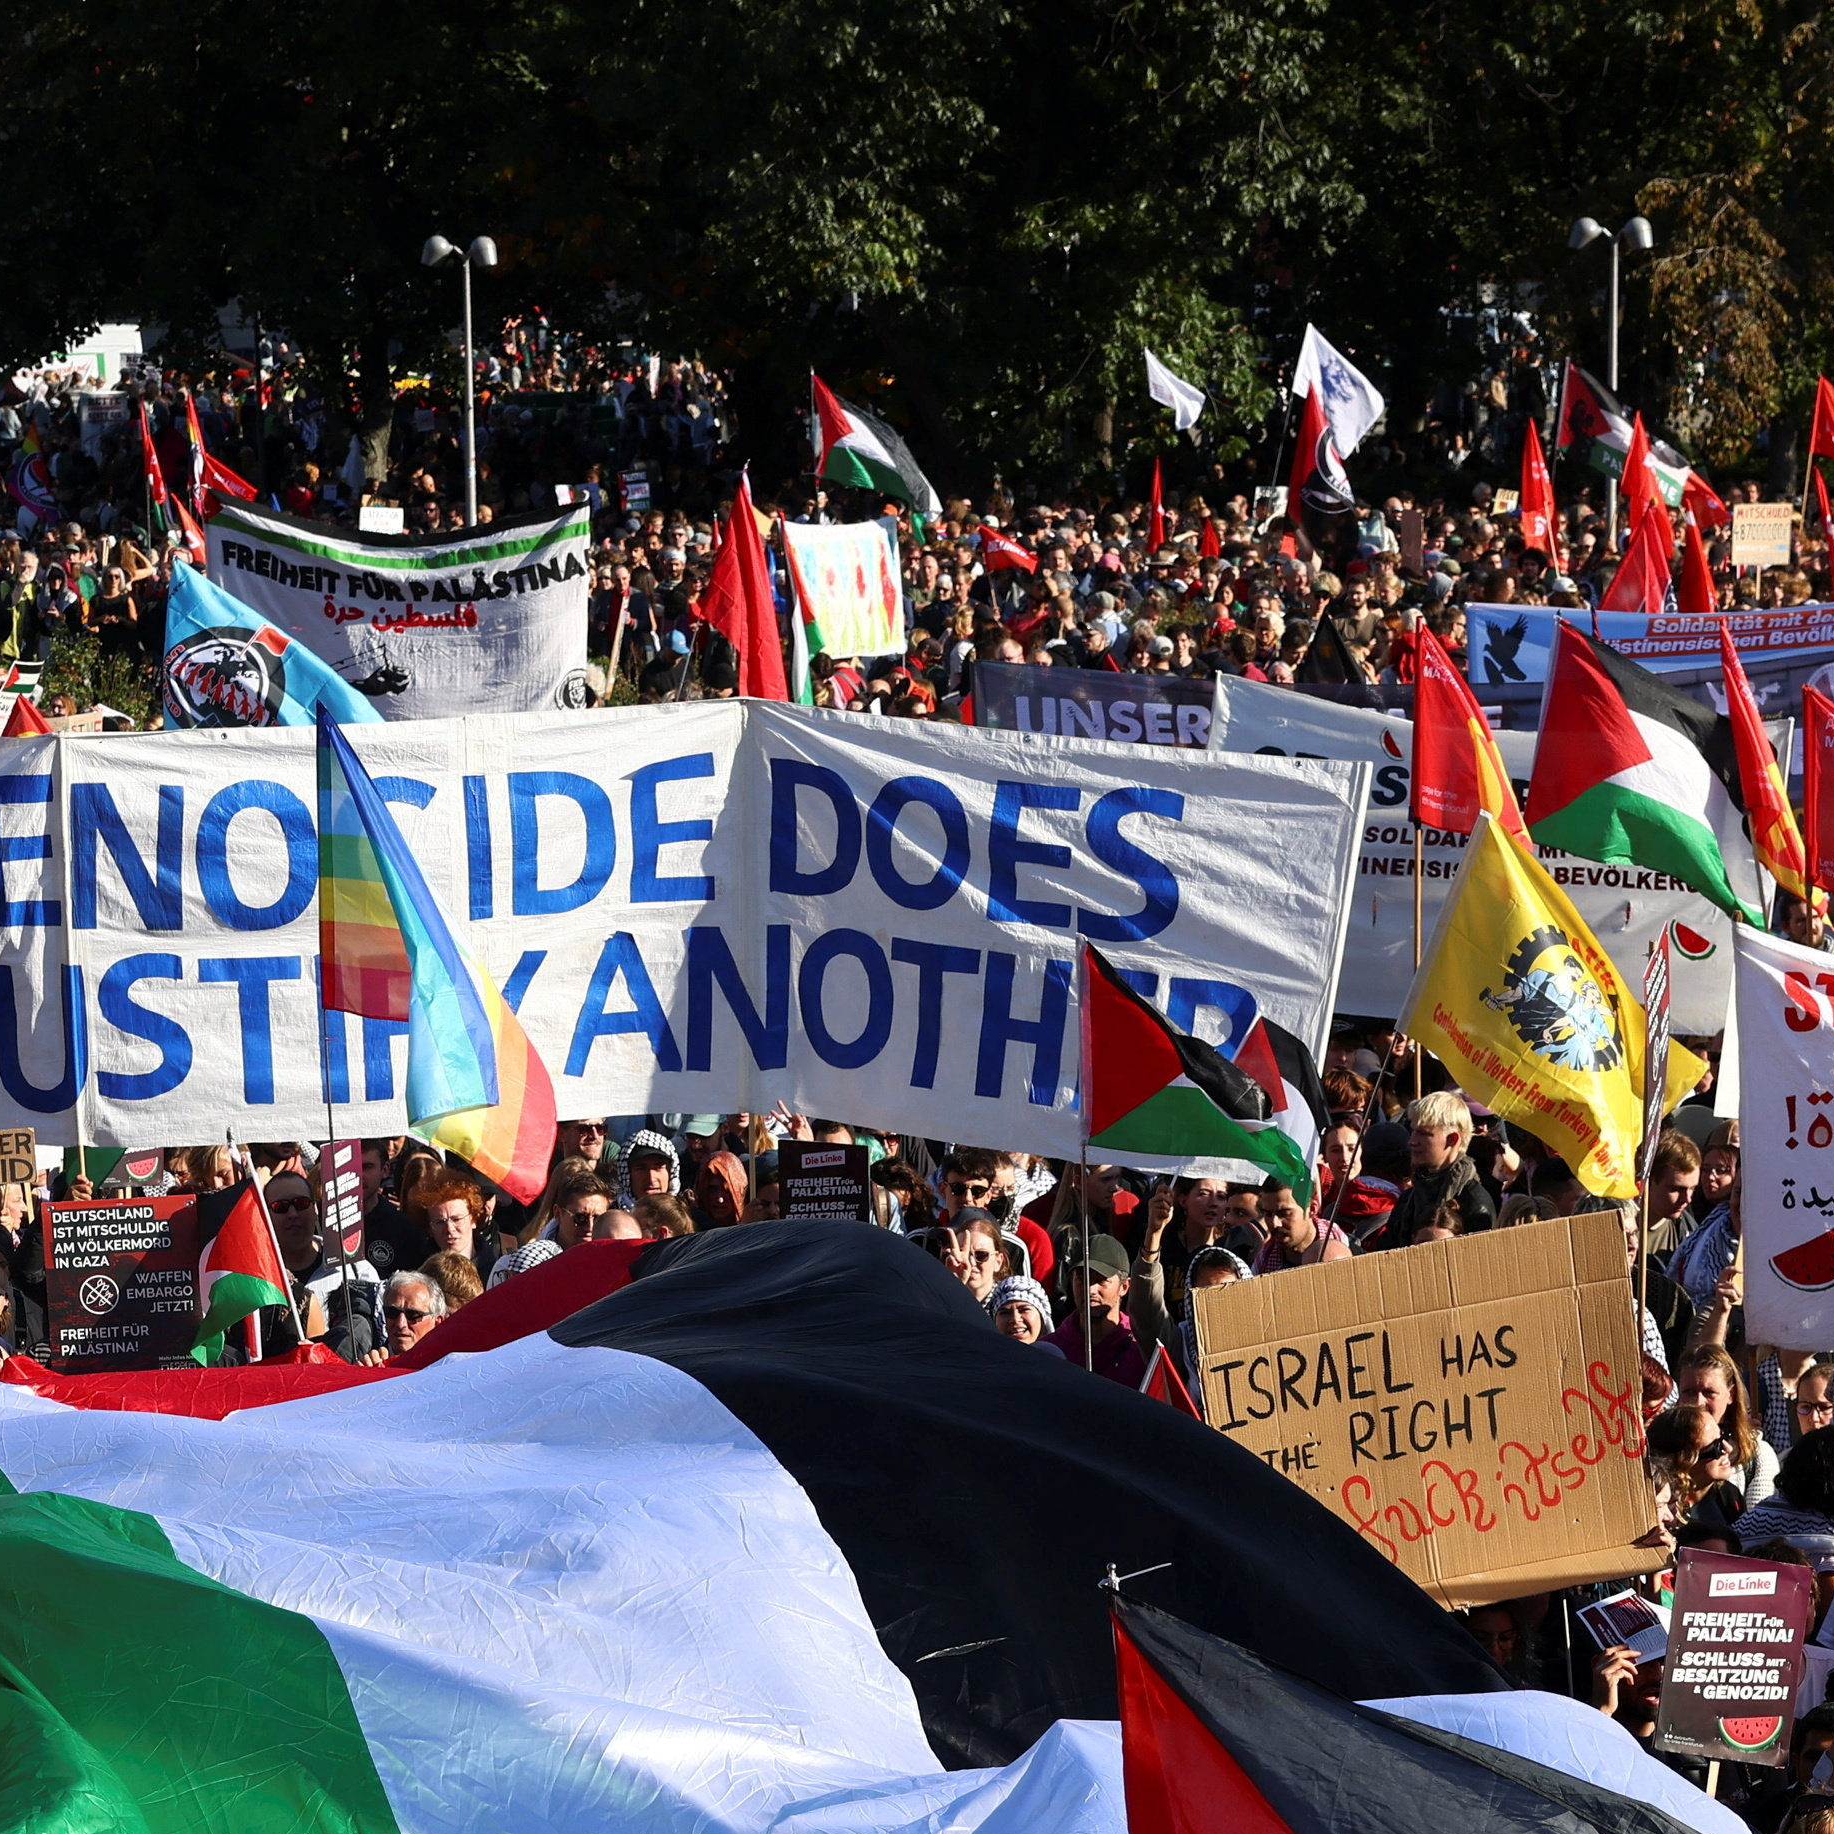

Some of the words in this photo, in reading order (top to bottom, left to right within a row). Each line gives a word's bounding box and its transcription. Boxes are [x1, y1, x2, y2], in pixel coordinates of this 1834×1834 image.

[222, 539, 341, 595] FREIHEIT
[347, 572, 409, 601] FÜR
[1768, 614, 1801, 630] mit
[768, 757, 1186, 942] DOES
[1472, 1048, 1483, 1067] of
[1482, 1046, 1528, 1096] Workers
[1524, 1081, 1556, 1114] From
[1556, 1101, 1593, 1144] Turkey
[805, 1157, 820, 1166] Die
[820, 1154, 843, 1164] Linke
[787, 1176, 842, 1188] FREIHEIT
[791, 1184, 863, 1198] PALÄSTINA!
[52, 1206, 154, 1225] DEUTSCHLAND
[789, 1201, 846, 1214] SCHLUSS
[53, 1224, 74, 1239] IST
[76, 1220, 171, 1238] MITSCHULDIG
[54, 1238, 76, 1255] AM
[78, 1234, 172, 1253] VÖLKERMORD
[54, 1255, 70, 1270] IN
[71, 1254, 110, 1269] GAZA
[135, 1269, 194, 1285] WAFFEN
[125, 1284, 194, 1300] EMBARGO
[149, 1299, 195, 1314] JETZT!
[60, 1326, 120, 1342] FREIHEIT
[122, 1323, 150, 1337] FÜR
[61, 1338, 140, 1357] PALÄSTINA!
[1209, 1330, 1415, 1432] ISRAEL
[1440, 1325, 1519, 1379] HAS
[1260, 1438, 1322, 1475] THE
[1348, 1386, 1508, 1468] RIGHT
[1340, 1459, 1498, 1567] fuck
[1495, 1360, 1648, 1522] itself
[1716, 1579, 1735, 1592] Die
[1738, 1576, 1771, 1591] Linke
[1682, 1612, 1767, 1628] FREIHEIT
[1763, 1616, 1785, 1628] FÜR
[1686, 1621, 1795, 1643] PALÄSTINA!
[1680, 1651, 1766, 1667] SCHLUSS
[1766, 1658, 1786, 1668] MIT
[1671, 1668, 1780, 1684] BESATZUNG
[1693, 1684, 1702, 1695] &
[1702, 1685, 1790, 1701] GENOZID!
